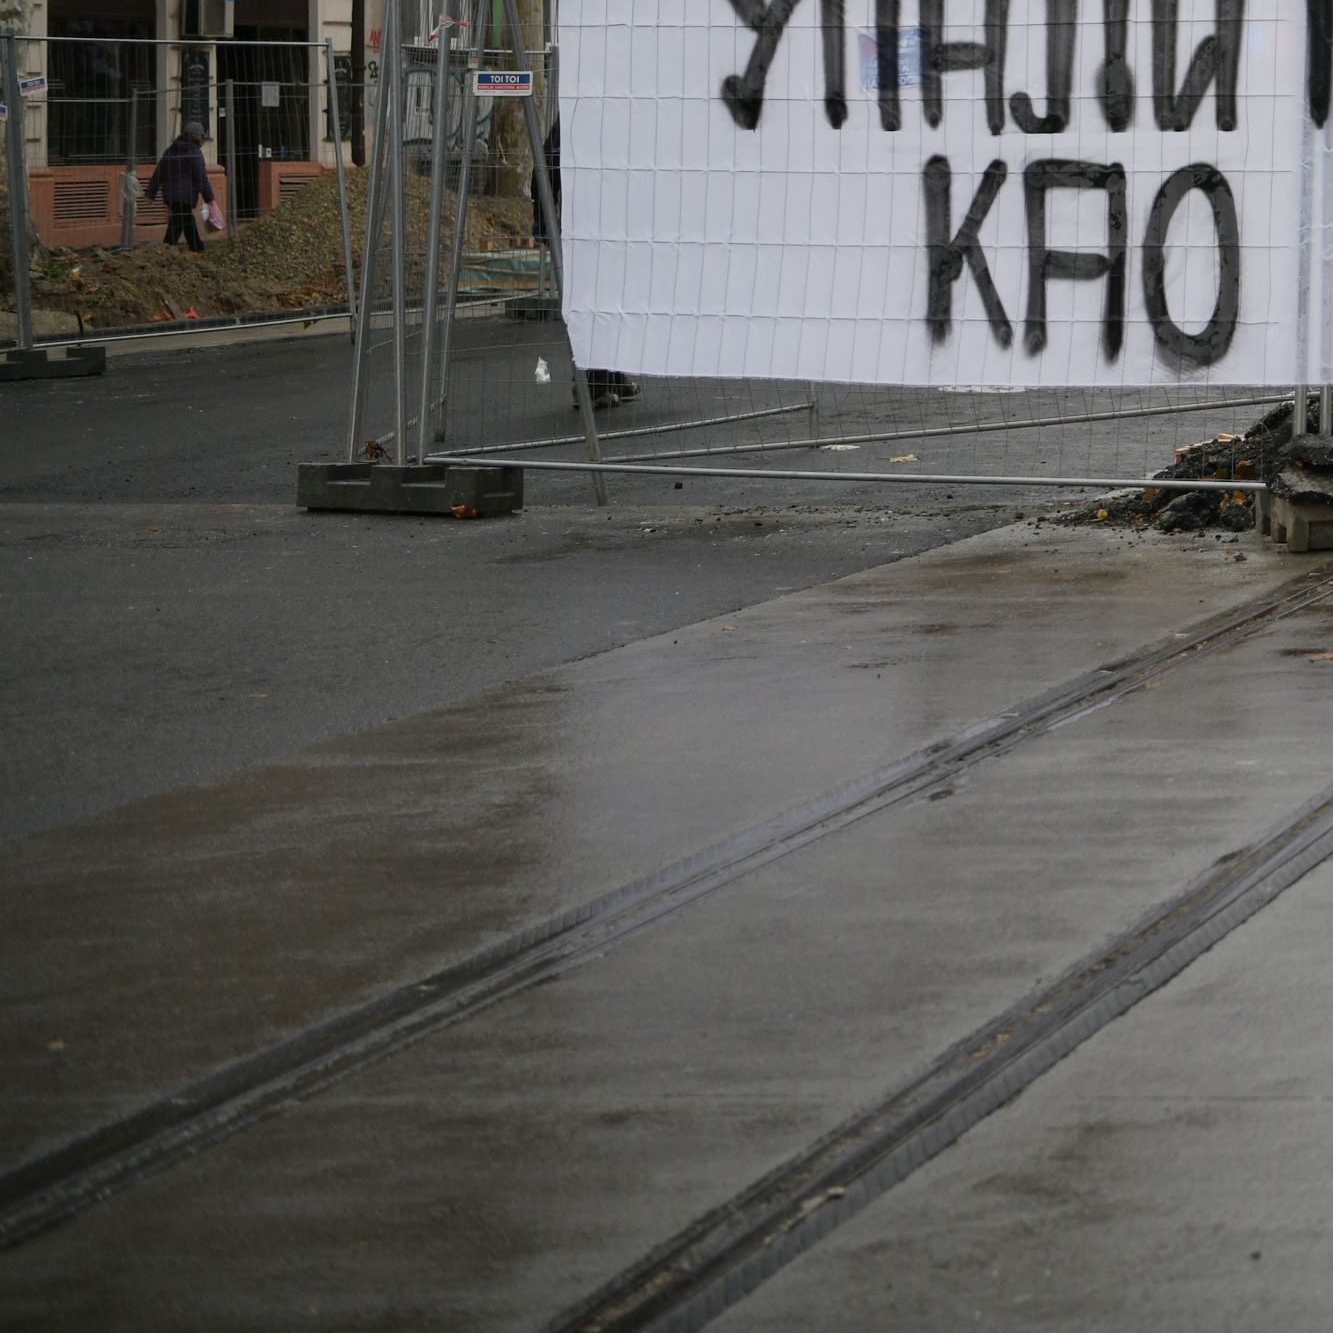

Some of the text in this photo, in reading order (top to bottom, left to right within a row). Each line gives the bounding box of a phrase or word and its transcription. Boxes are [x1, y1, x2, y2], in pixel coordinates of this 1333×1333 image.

[490, 75, 520, 83] TOI TOI
[922, 153, 1241, 368] КАО
